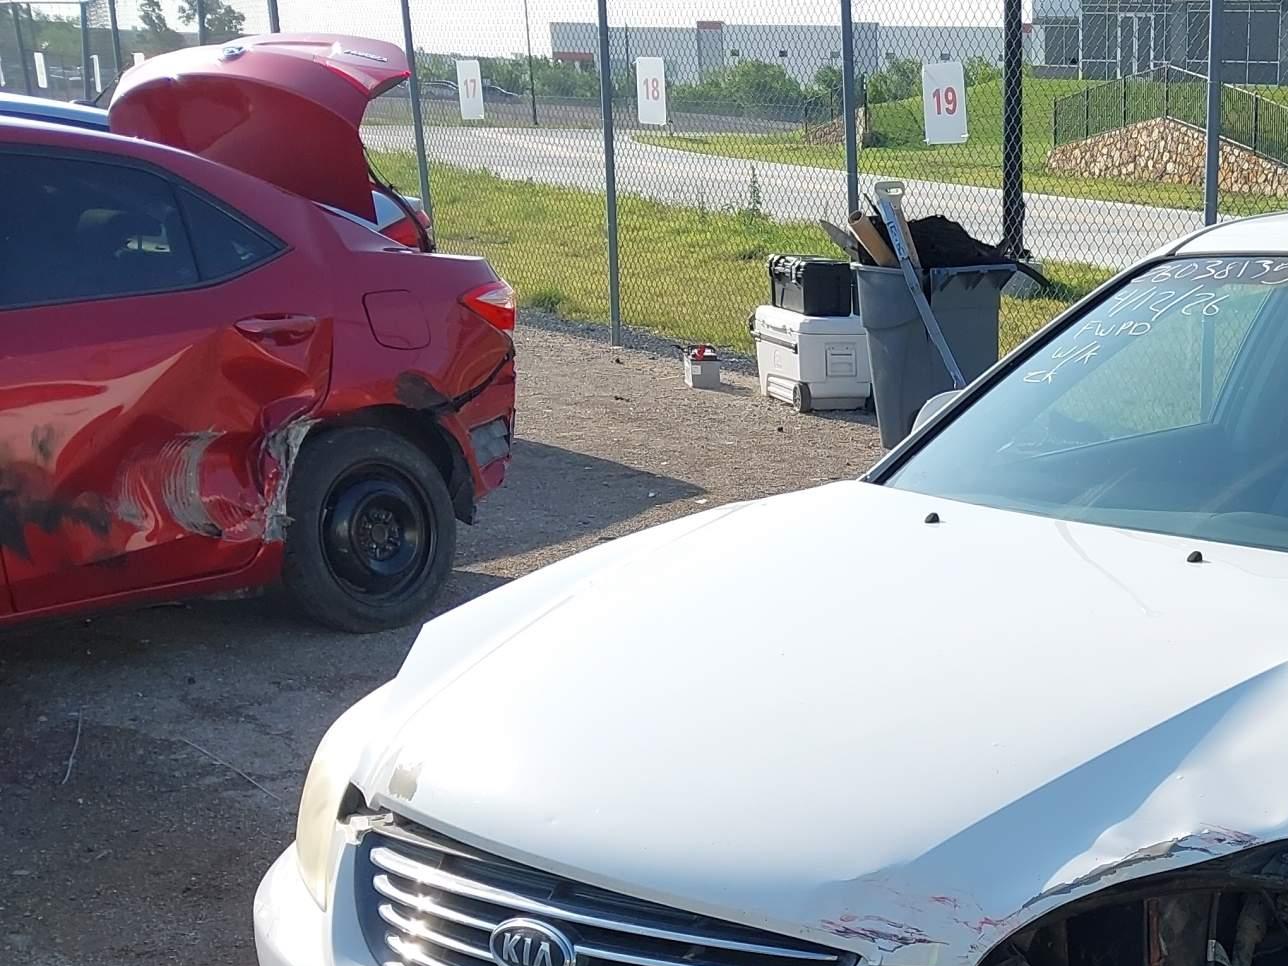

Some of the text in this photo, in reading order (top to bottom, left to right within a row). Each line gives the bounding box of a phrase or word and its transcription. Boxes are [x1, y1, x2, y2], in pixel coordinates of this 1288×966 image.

[464, 79, 477, 99] 17
[643, 77, 660, 101] 18
[932, 86, 957, 116] 19
[1108, 284, 1230, 321] 4/12/26
